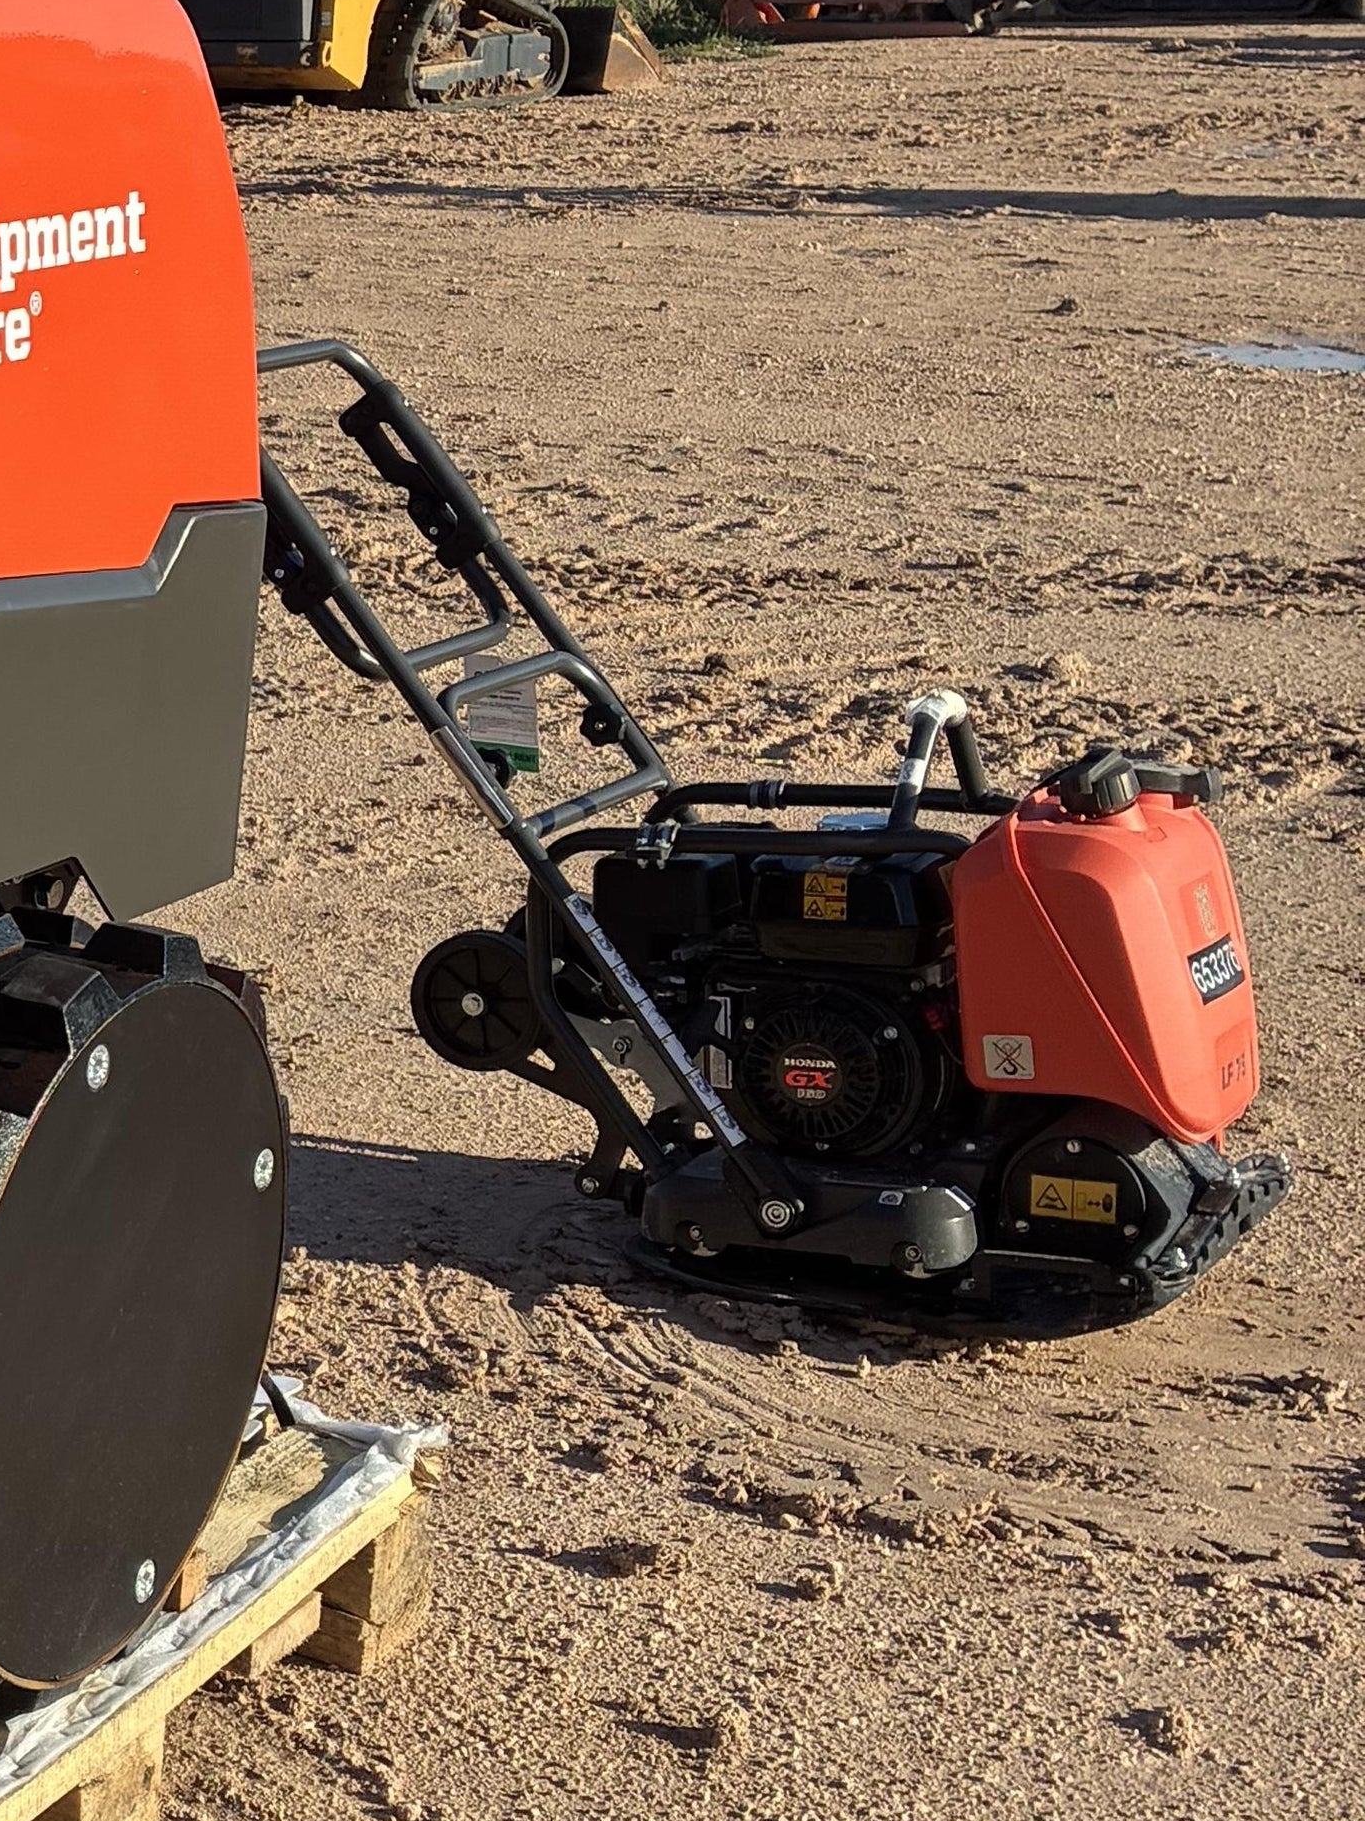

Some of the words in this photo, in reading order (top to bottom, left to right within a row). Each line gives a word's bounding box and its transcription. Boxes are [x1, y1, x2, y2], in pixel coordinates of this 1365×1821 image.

[783, 1058, 837, 1069] HONDA
[784, 1070, 836, 1089] GX
[1221, 1062, 1234, 1091] LF
